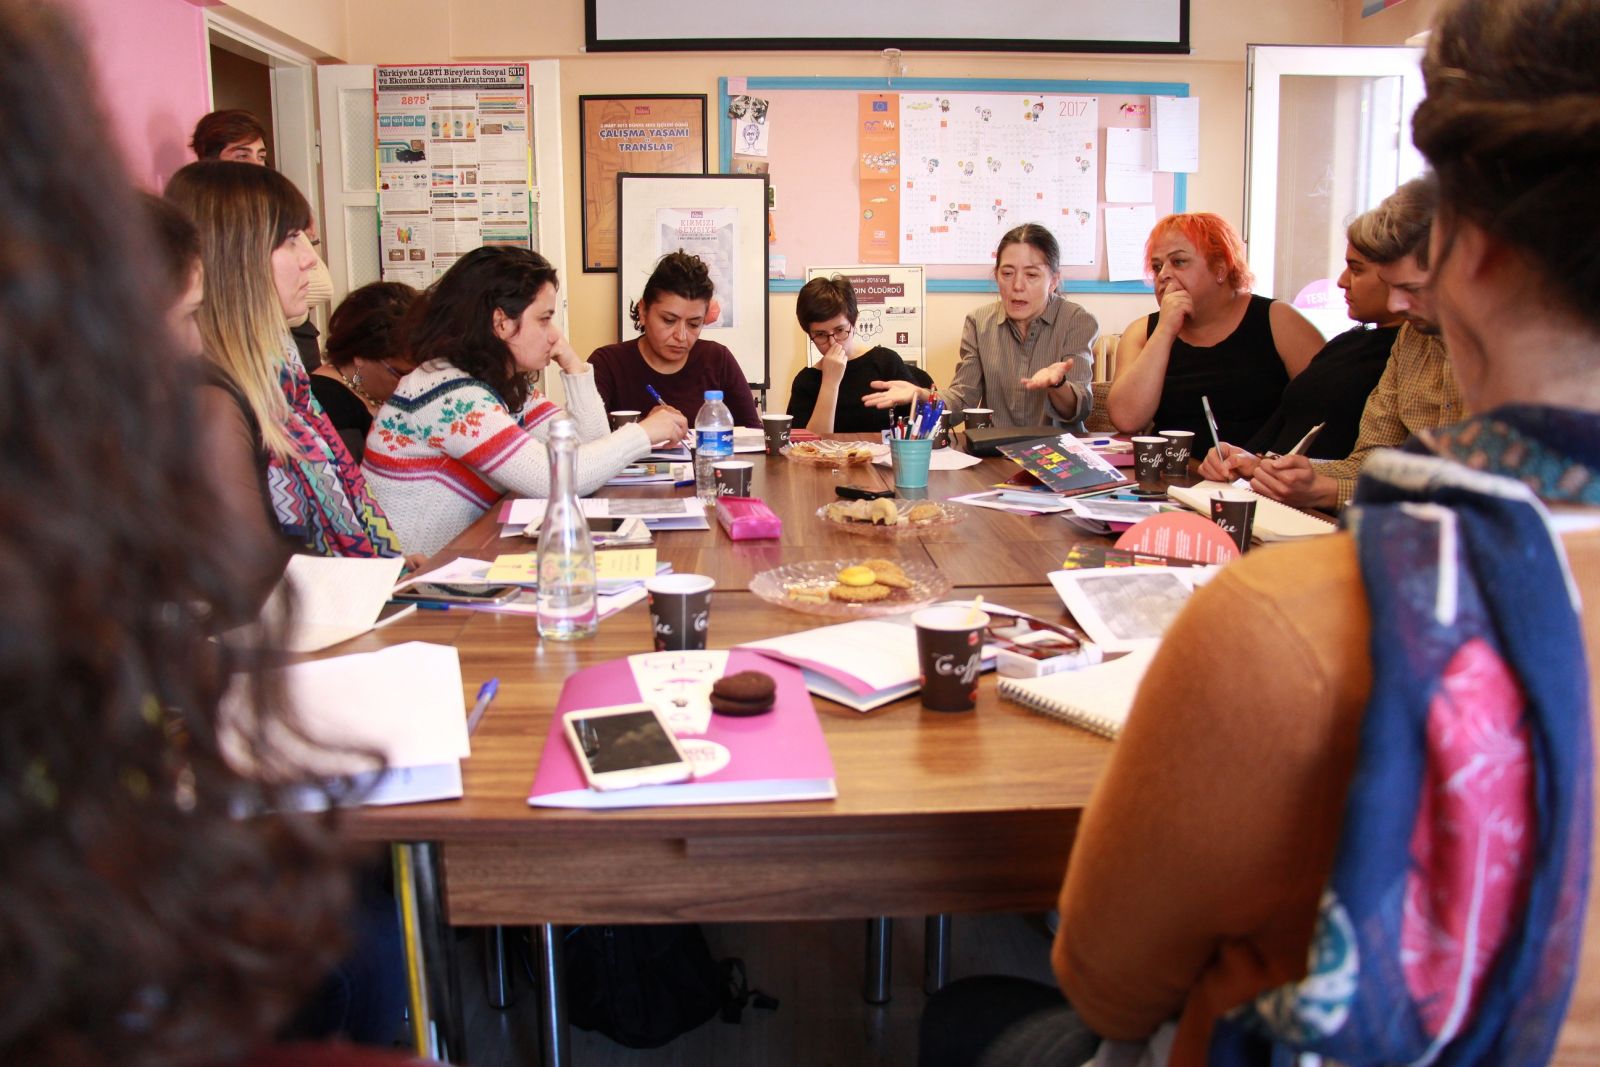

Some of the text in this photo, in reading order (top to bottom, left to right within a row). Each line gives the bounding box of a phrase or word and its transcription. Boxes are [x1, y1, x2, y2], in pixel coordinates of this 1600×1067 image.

[379, 67, 506, 77] Türkiye'de LGBTİ Bireylerin Sosyal
[427, 76, 461, 84] Sorunları
[462, 76, 506, 85] Araştırması
[401, 96, 426, 105] 2875
[1059, 101, 1088, 117] 2017
[600, 129, 689, 139] ÇALIŞMA YAŞAMI
[619, 143, 673, 151] TRANSLAR
[867, 285, 902, 294] ÖLDÜRDÜ
